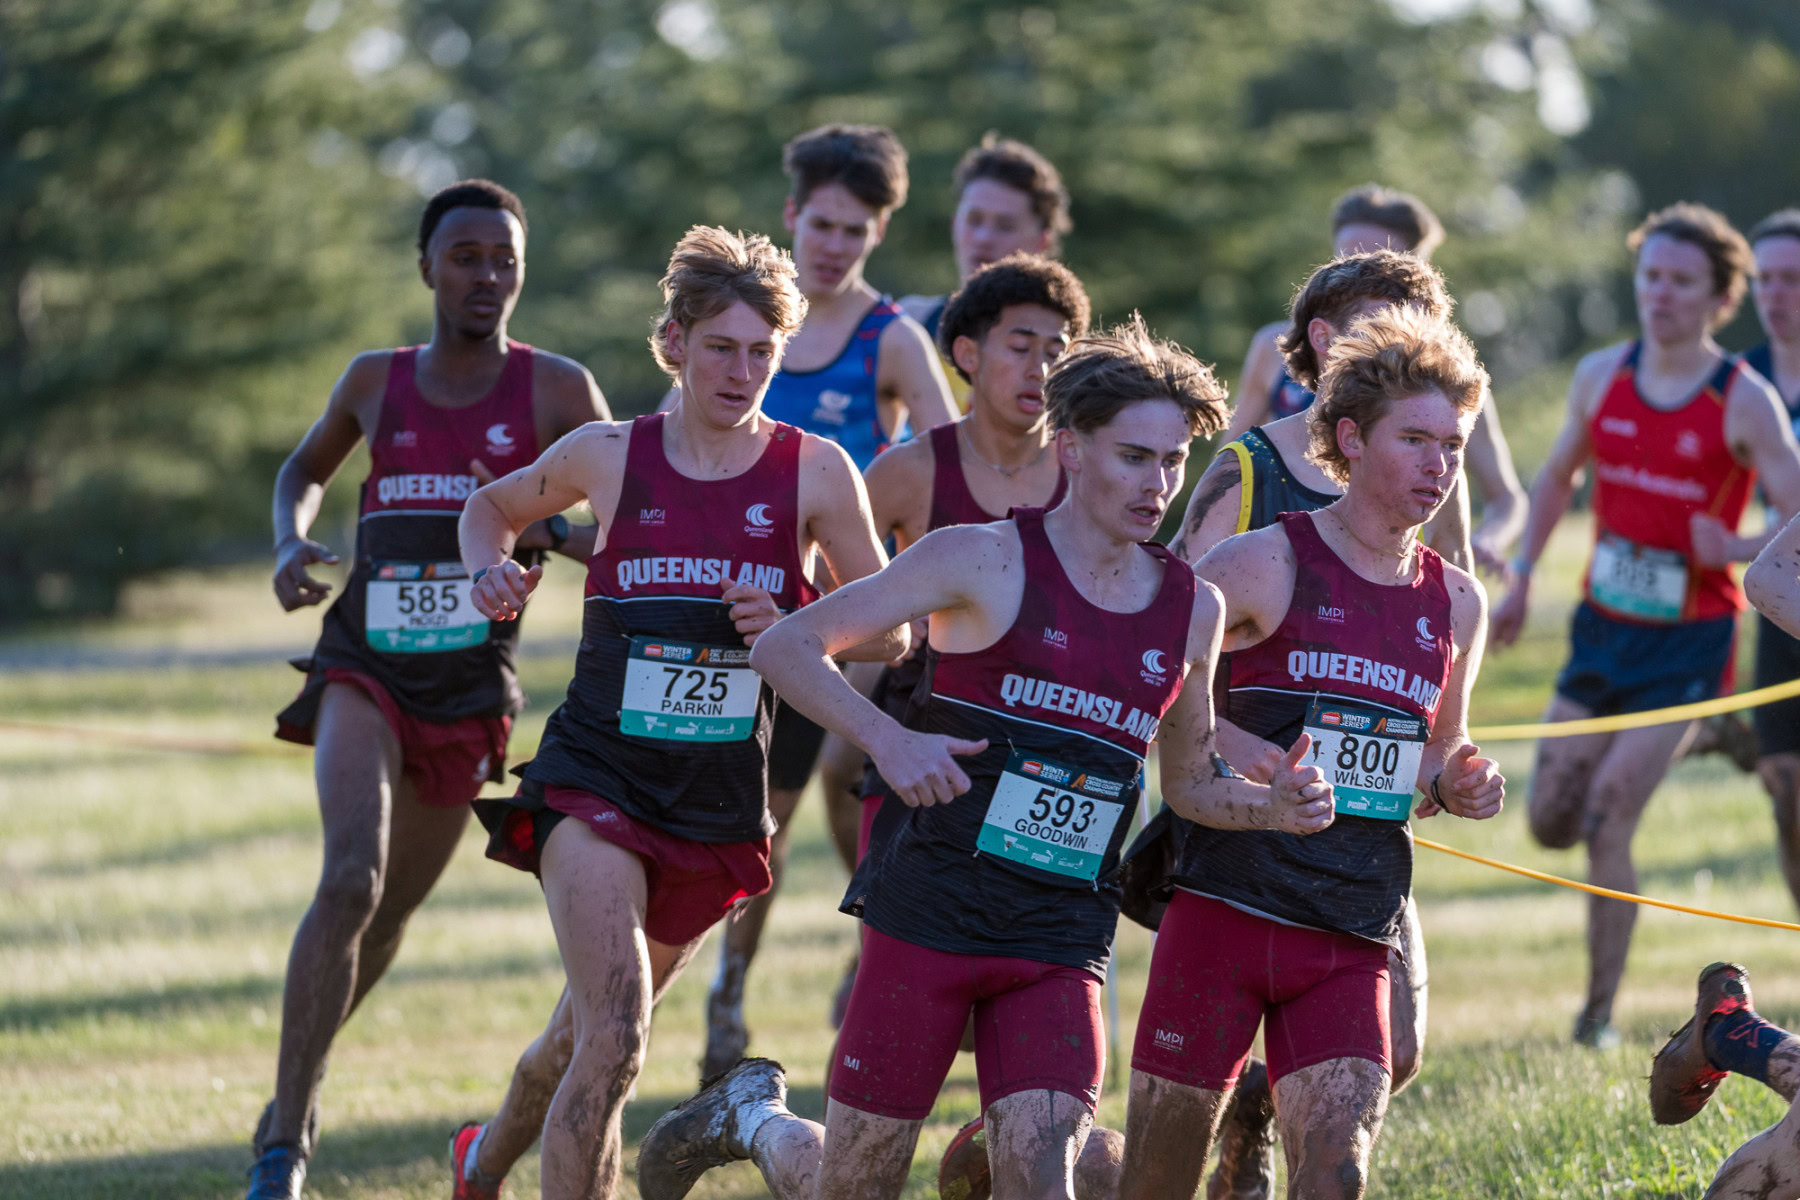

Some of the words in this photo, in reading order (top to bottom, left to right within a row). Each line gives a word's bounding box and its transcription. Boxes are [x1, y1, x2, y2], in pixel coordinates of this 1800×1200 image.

[398, 584, 458, 614] 585
[1318, 604, 1345, 619] IMPI
[1043, 626, 1068, 645] IMPI
[662, 652, 686, 660] SERIES
[663, 645, 692, 655] WINTER
[663, 667, 729, 702] 725
[1288, 650, 1442, 714] QUEENSLAND
[661, 699, 723, 716] PARKIN
[1342, 712, 1371, 724] WINTER
[1336, 736, 1399, 776] 800
[1335, 769, 1395, 791] WILSON
[1029, 787, 1095, 833] 593
[1015, 818, 1088, 850] GOODWIN
[1155, 1028, 1184, 1047] IMPI
